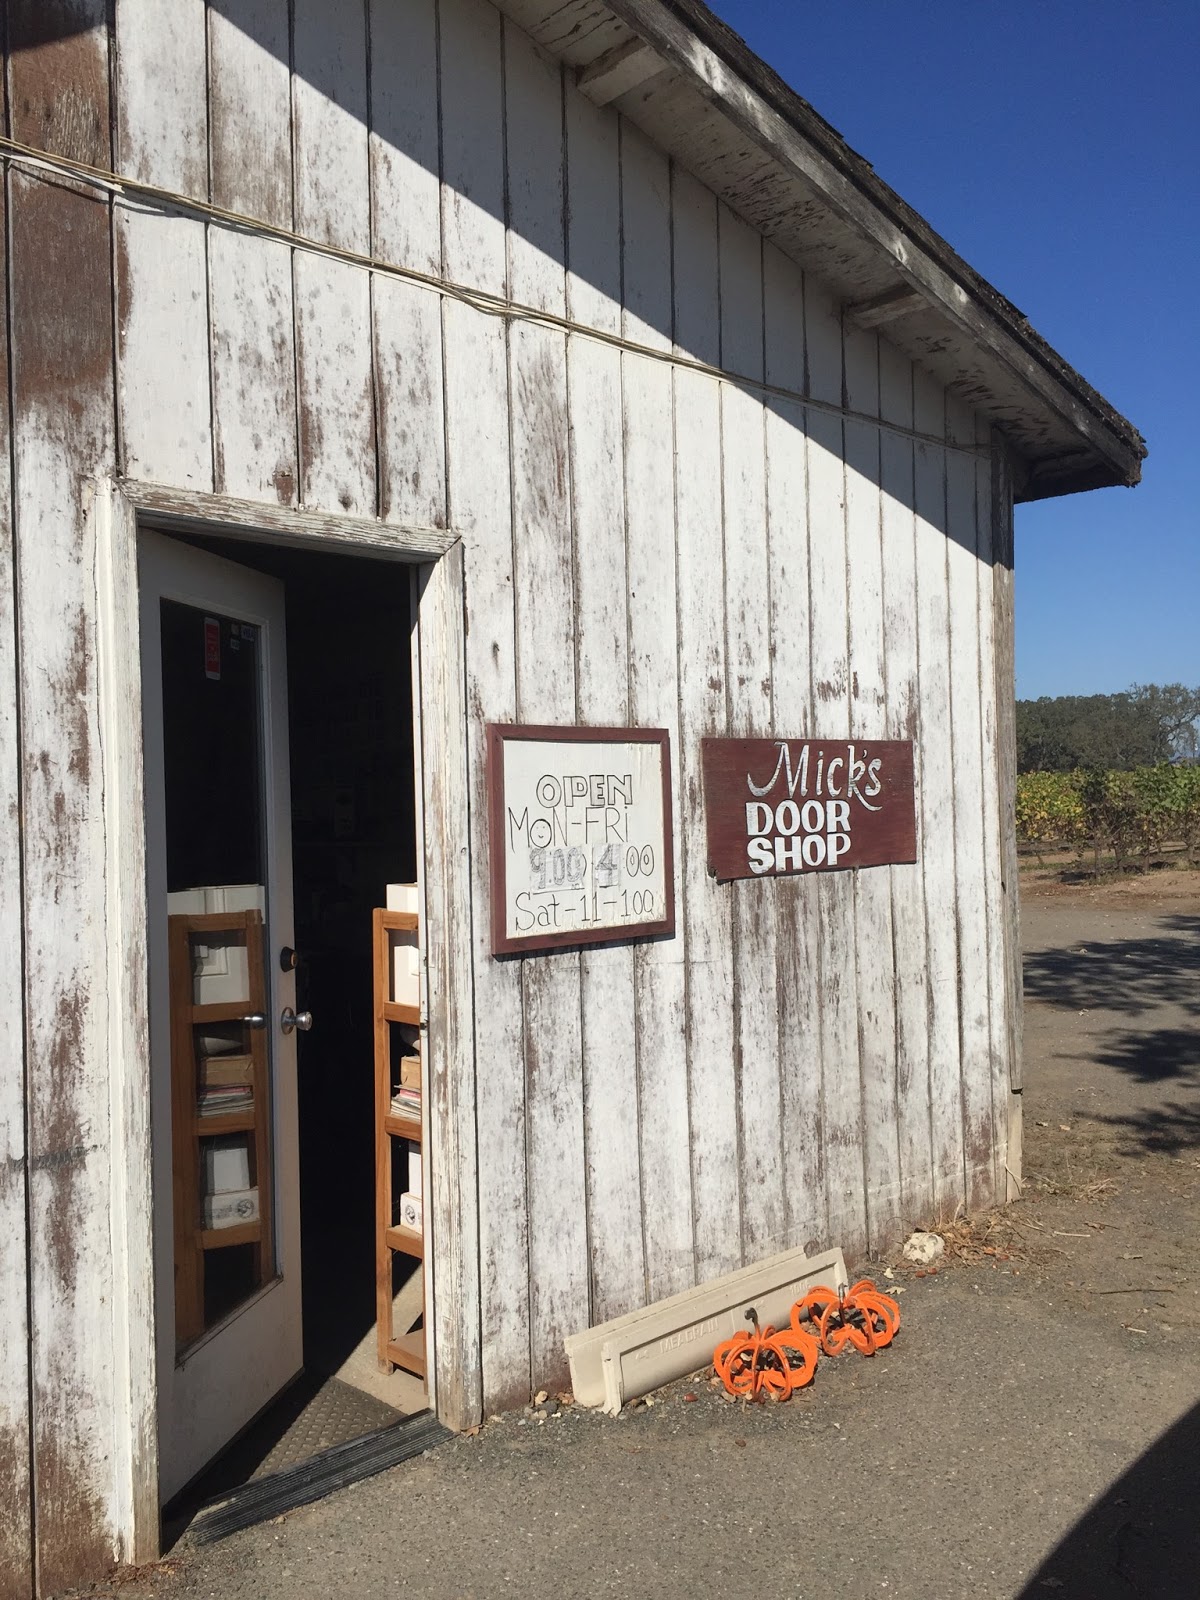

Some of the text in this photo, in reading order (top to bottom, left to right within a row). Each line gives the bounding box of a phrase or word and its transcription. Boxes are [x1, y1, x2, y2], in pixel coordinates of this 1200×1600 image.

[536, 774, 633, 808] OPEN
[747, 741, 883, 811] Mick's
[745, 799, 852, 836] DOOR
[747, 833, 852, 874] SHOP
